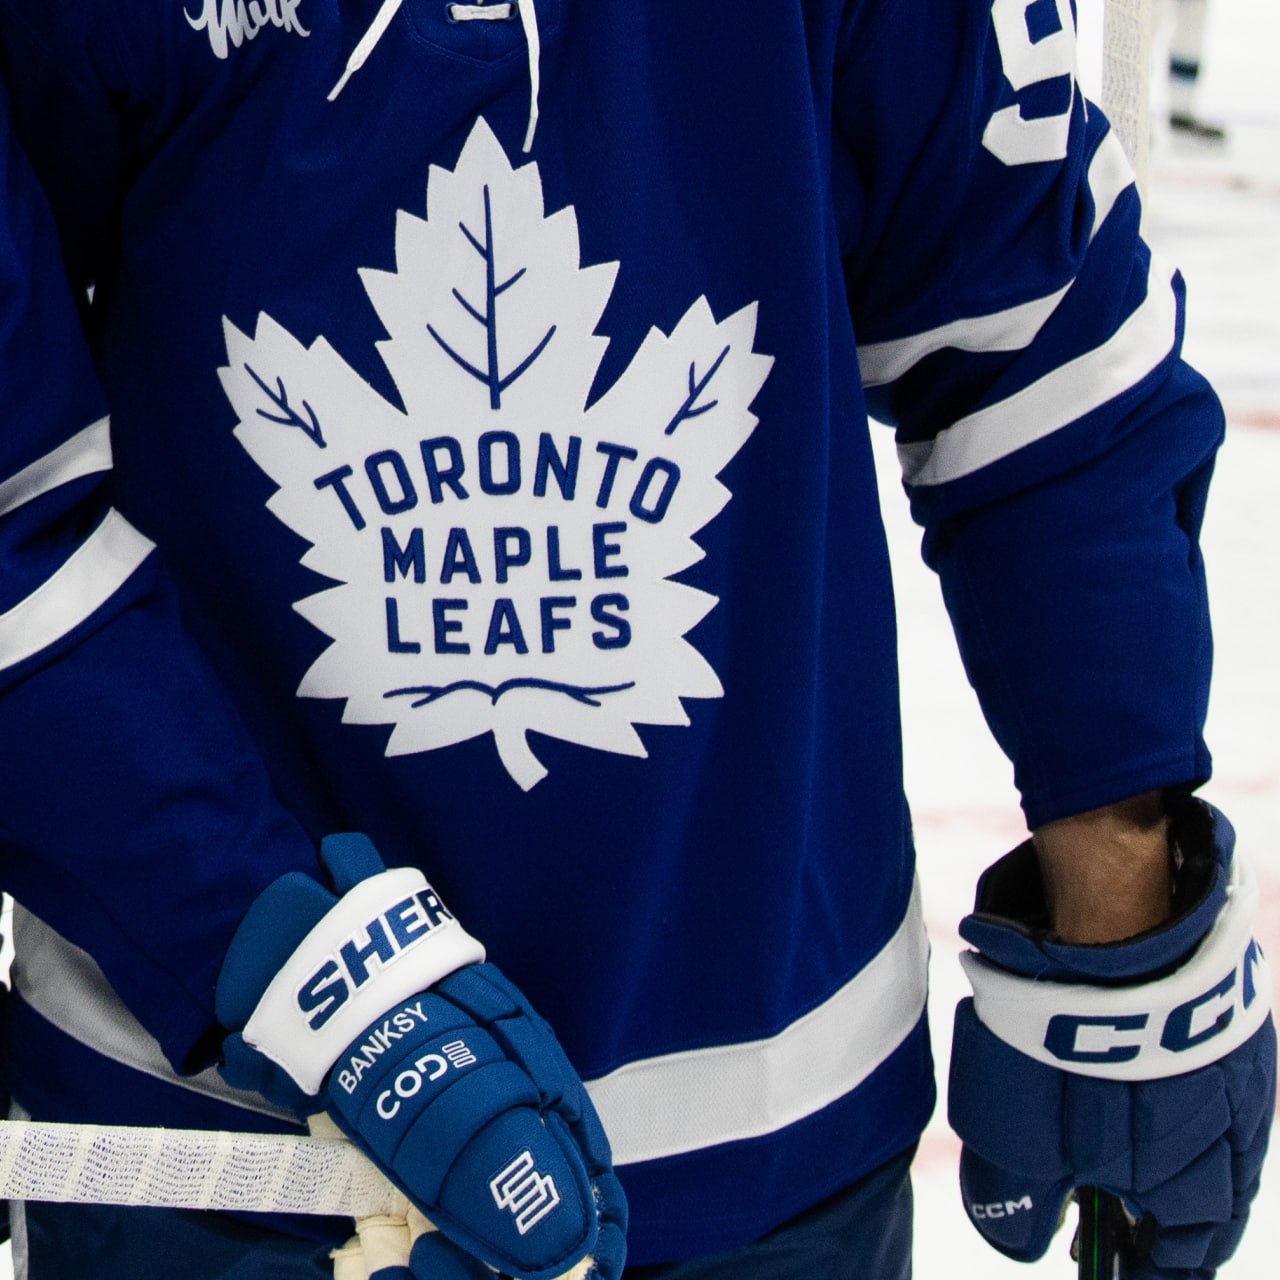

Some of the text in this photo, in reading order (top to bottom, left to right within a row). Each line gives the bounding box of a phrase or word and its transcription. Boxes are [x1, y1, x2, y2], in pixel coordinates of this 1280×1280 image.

[313, 430, 681, 531] TORONTO
[380, 521, 629, 584] MAPLE
[385, 592, 632, 656] LEAFS
[337, 1001, 428, 1095] BANKSY
[972, 1195, 1033, 1220] CCM
